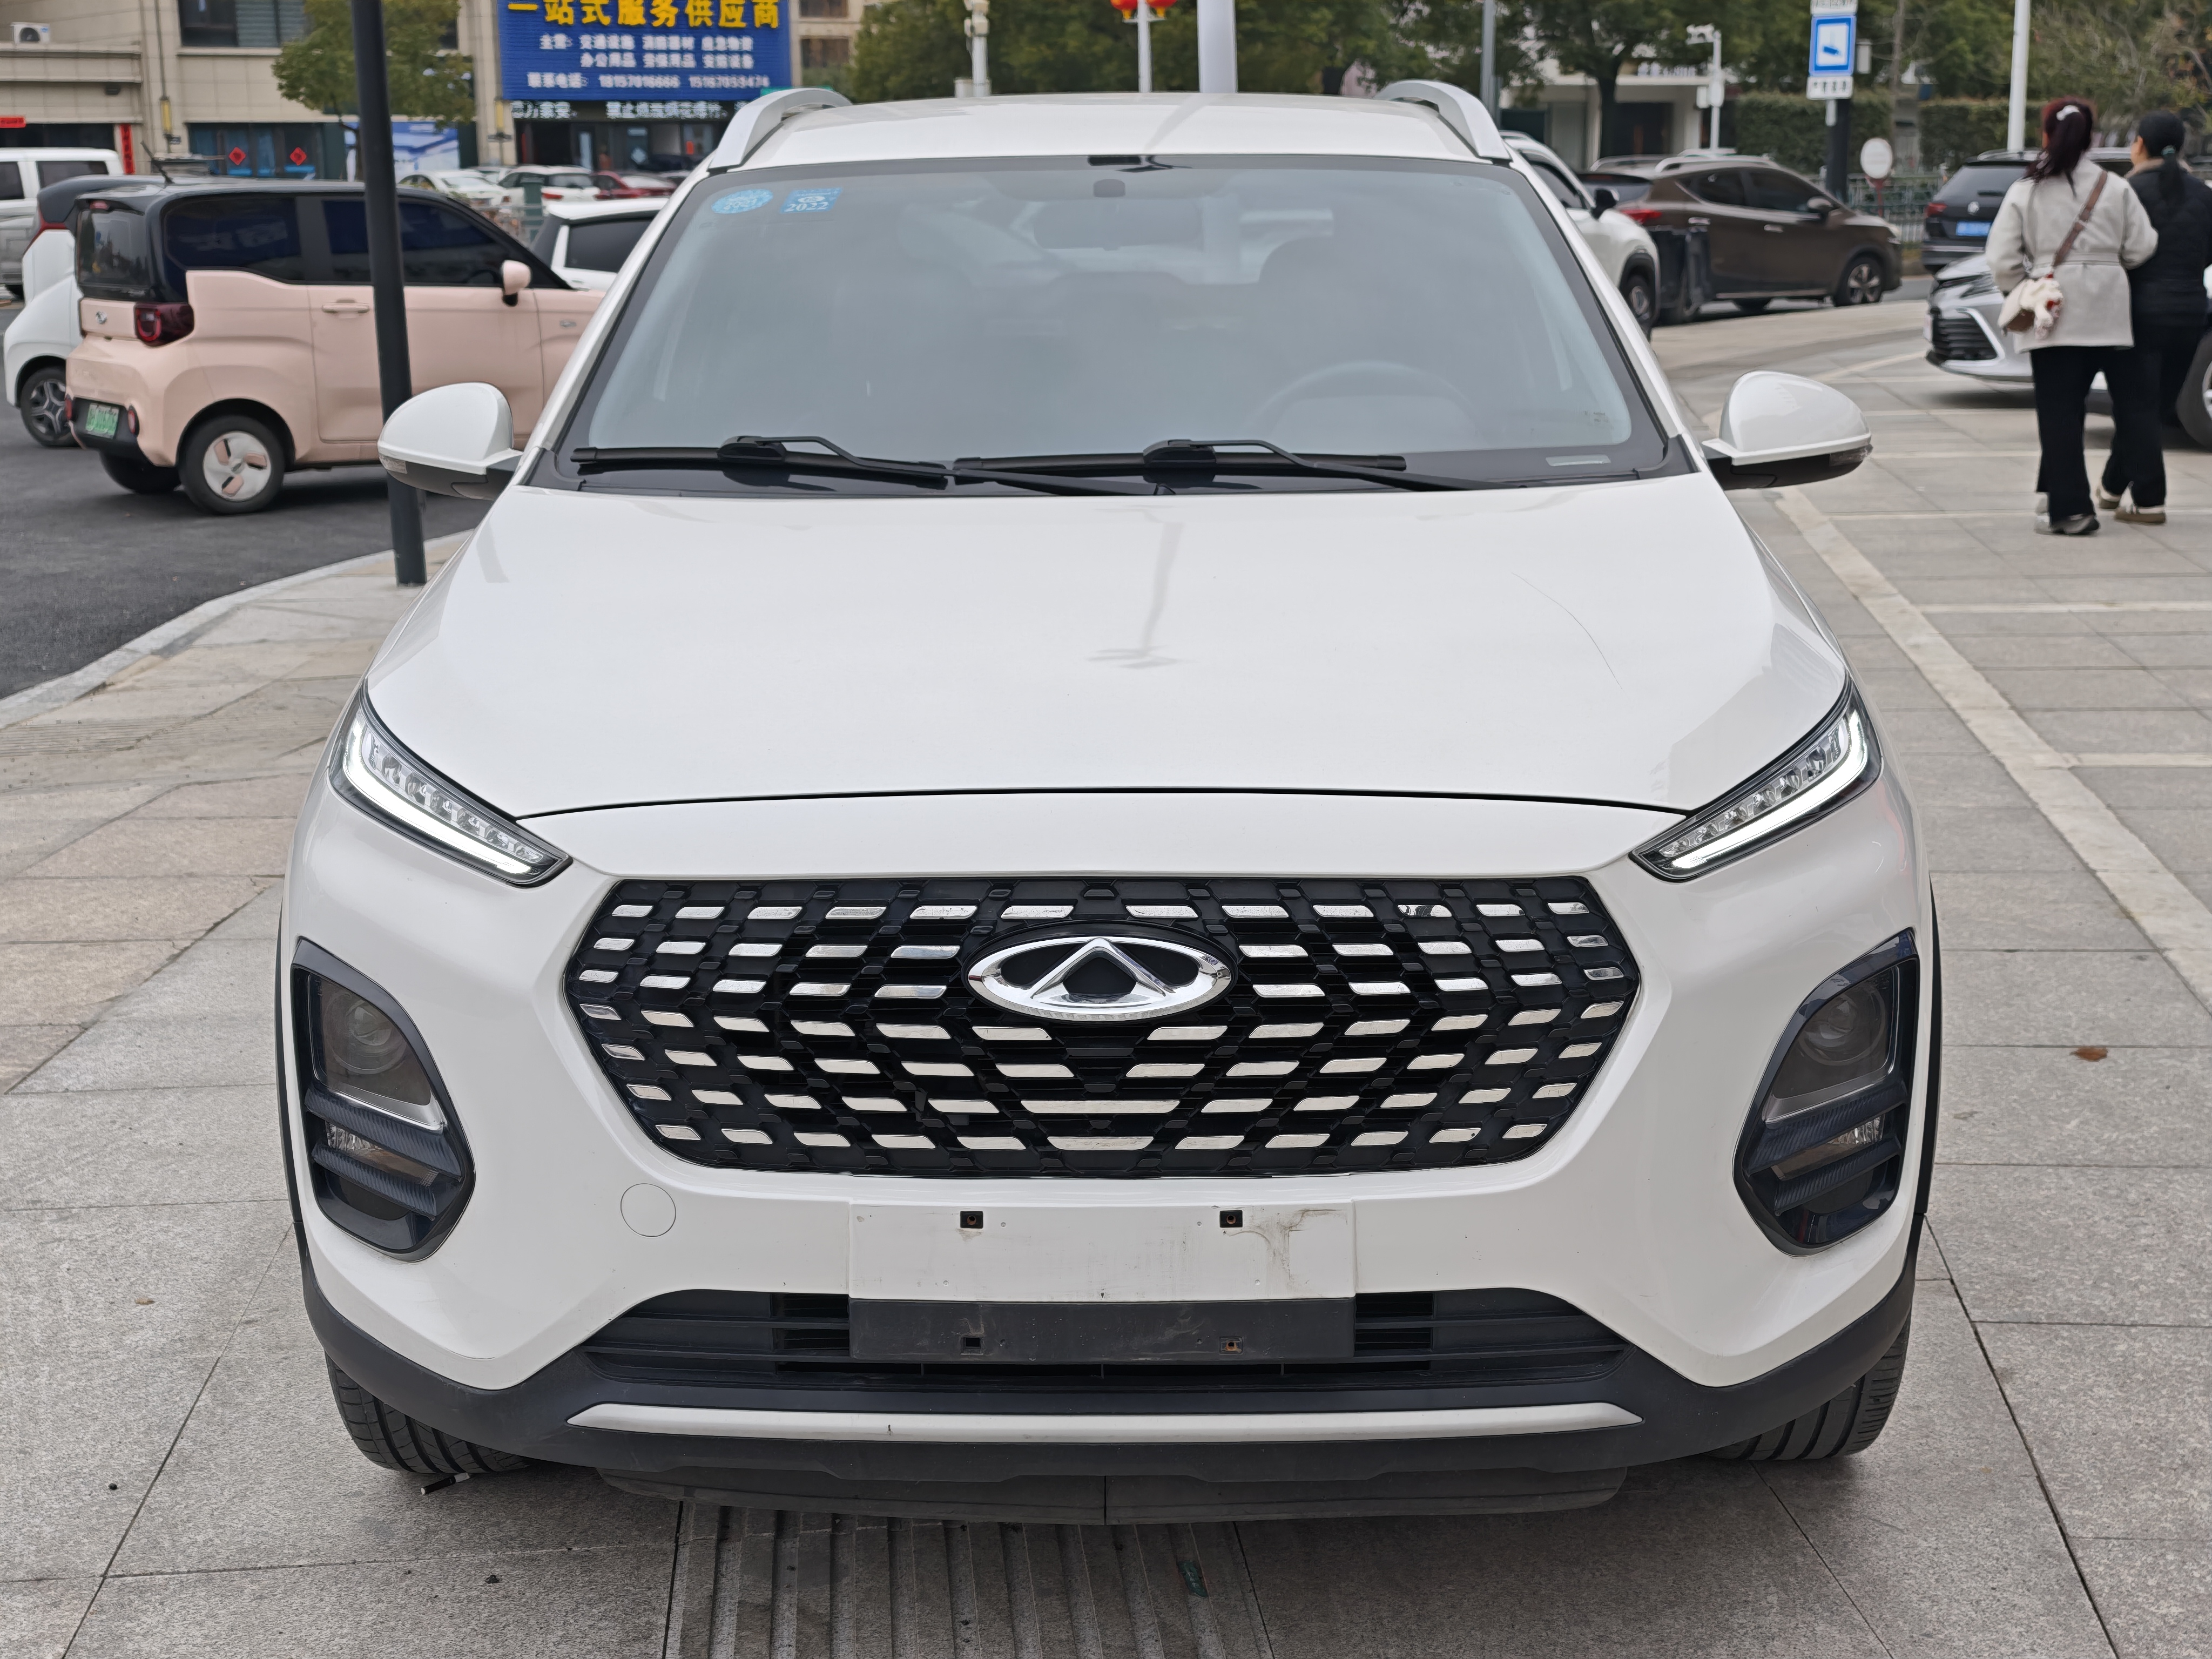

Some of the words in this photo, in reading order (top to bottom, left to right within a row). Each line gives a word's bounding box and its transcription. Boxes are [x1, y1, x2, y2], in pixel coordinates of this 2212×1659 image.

[508, 0, 779, 28] 一站式服务供应商
[784, 202, 829, 212] 2022
